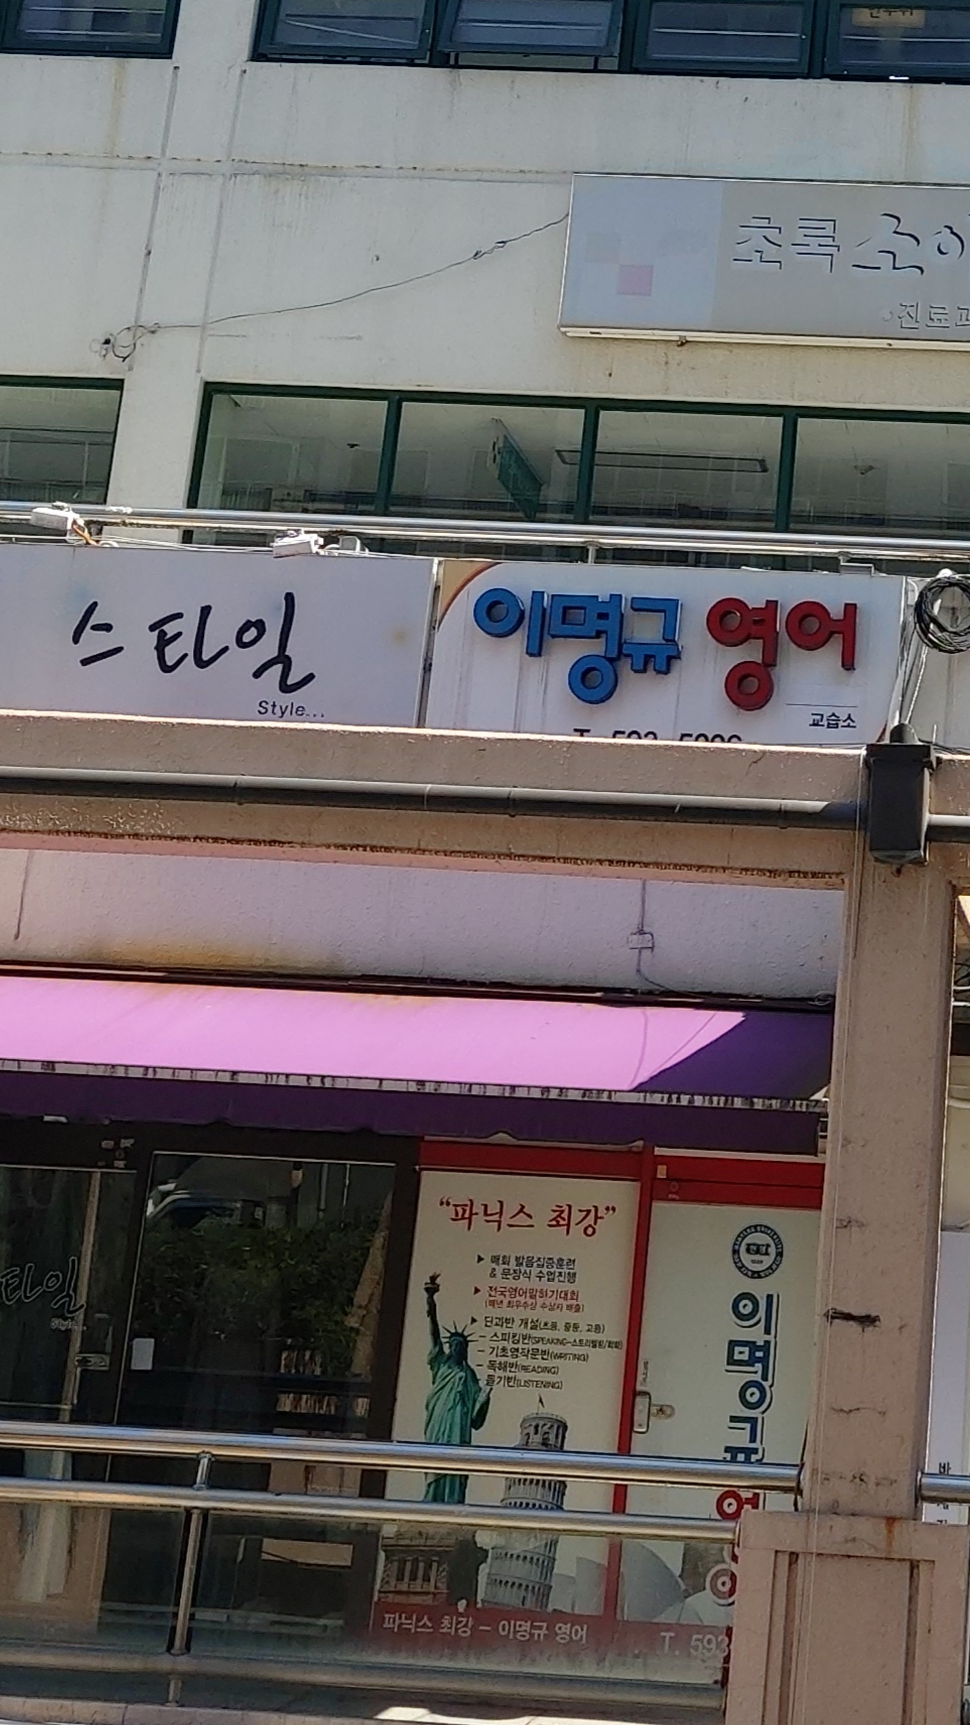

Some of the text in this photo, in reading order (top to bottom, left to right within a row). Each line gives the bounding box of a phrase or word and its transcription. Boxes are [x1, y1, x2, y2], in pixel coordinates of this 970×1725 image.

[71, 591, 317, 694] 스타일
[474, 587, 858, 712] 이명규 영어
[809, 712, 857, 729] 교습소
[383, 1612, 433, 1633] 파닉스
[440, 1615, 474, 1637] 최강
[498, 1620, 548, 1641] 이명규
[555, 1623, 588, 1644] 영어
